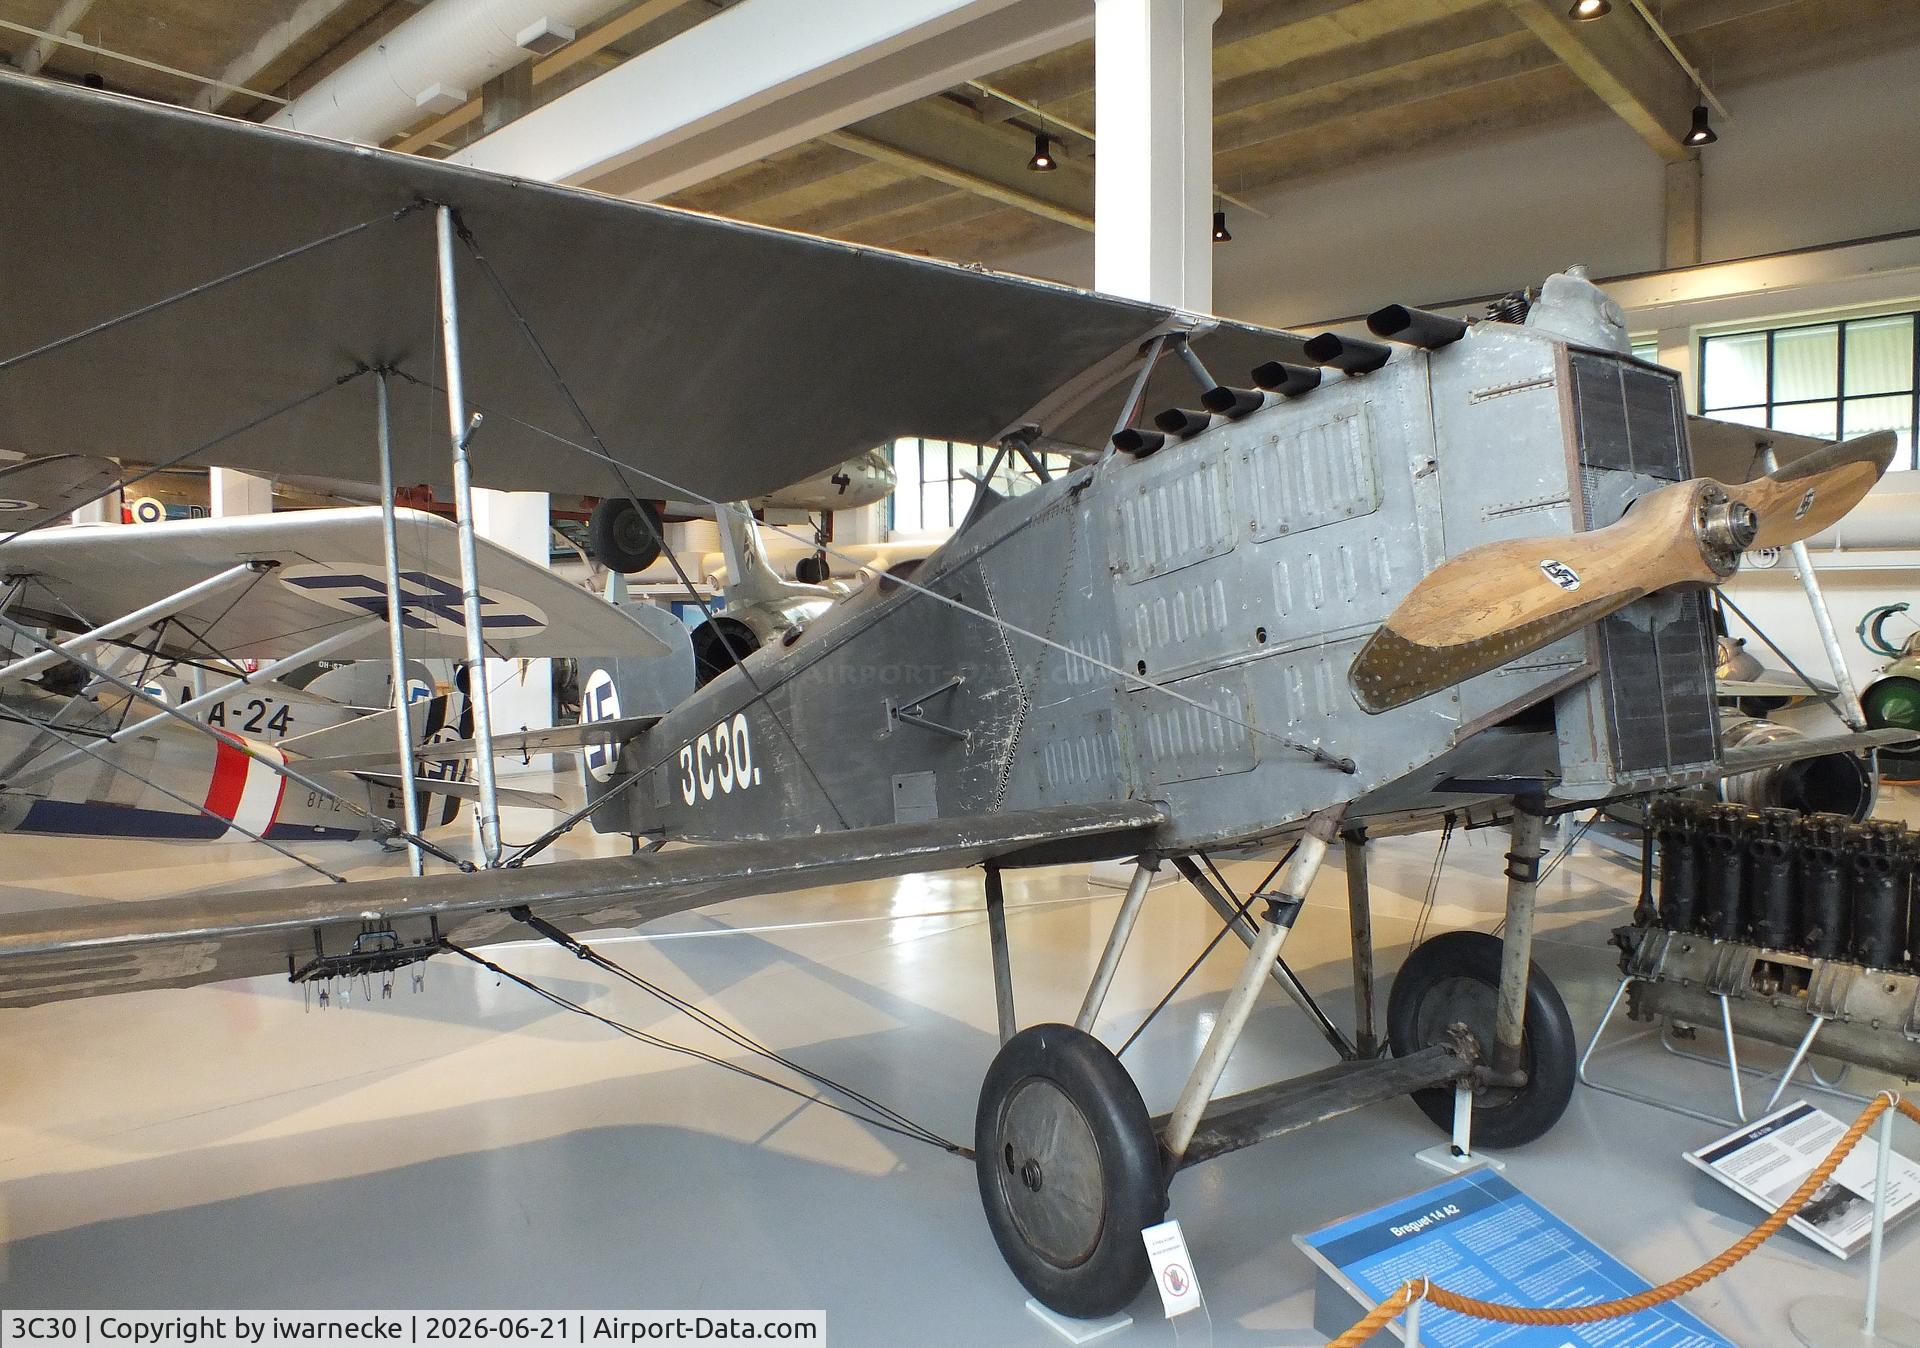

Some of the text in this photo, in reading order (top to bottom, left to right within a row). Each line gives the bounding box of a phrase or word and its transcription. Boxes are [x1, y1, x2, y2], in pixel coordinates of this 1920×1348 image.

[1389, 1203, 1462, 1237] Breguet 14 A2
